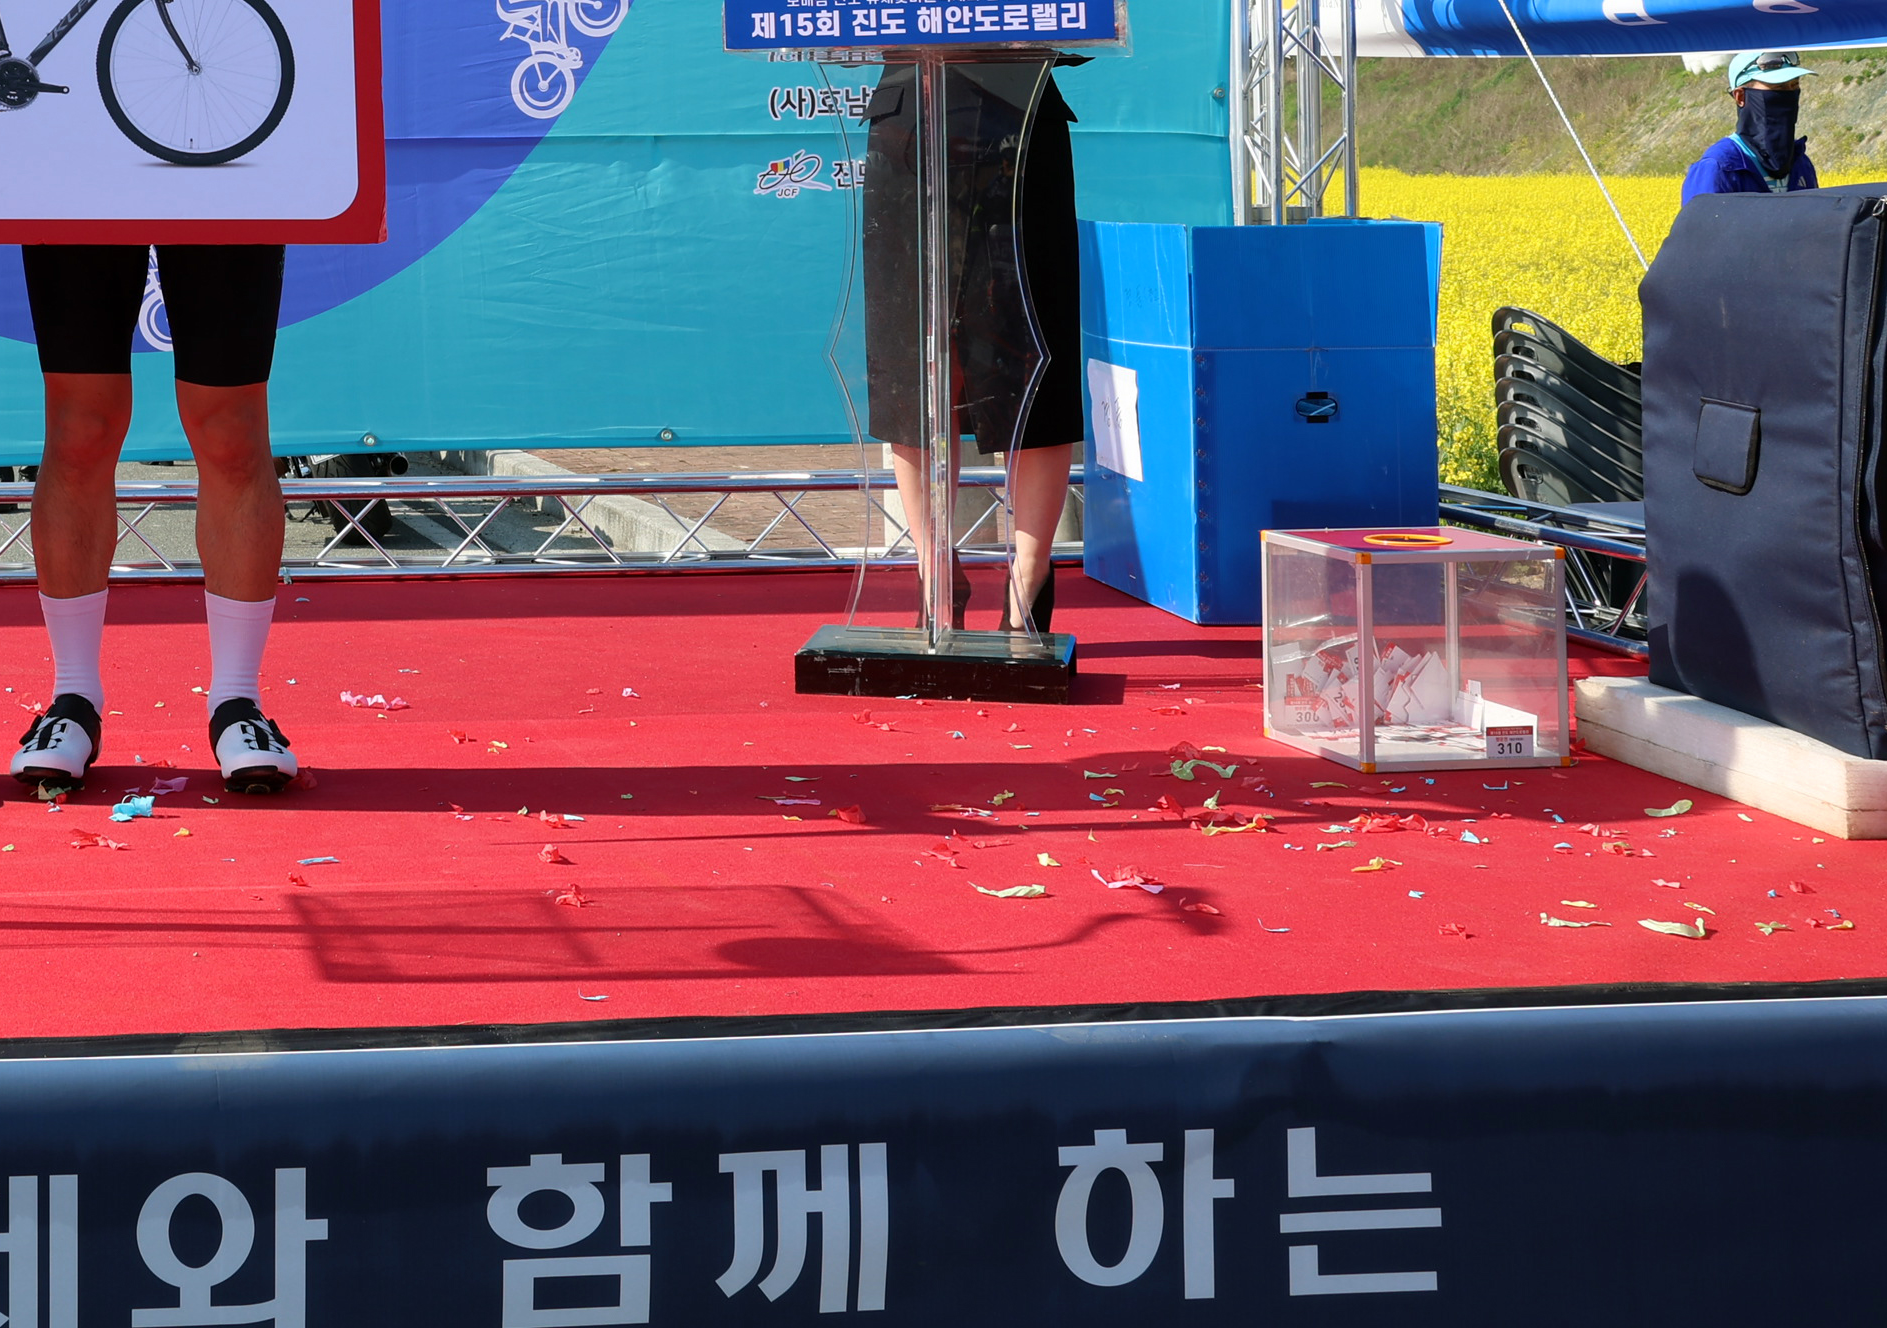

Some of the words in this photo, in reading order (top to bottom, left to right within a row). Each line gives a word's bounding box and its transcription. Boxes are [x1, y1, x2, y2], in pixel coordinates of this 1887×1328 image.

[751, 10, 840, 39] 제15회
[852, 8, 906, 36] 진도
[917, 1, 1087, 33] 해안도로랠리
[770, 85, 879, 119] (사)호남
[777, 188, 799, 197] JCF
[1497, 742, 1523, 755] 310
[486, 1141, 889, 1328] 함께
[1054, 1127, 1443, 1300] 하는
